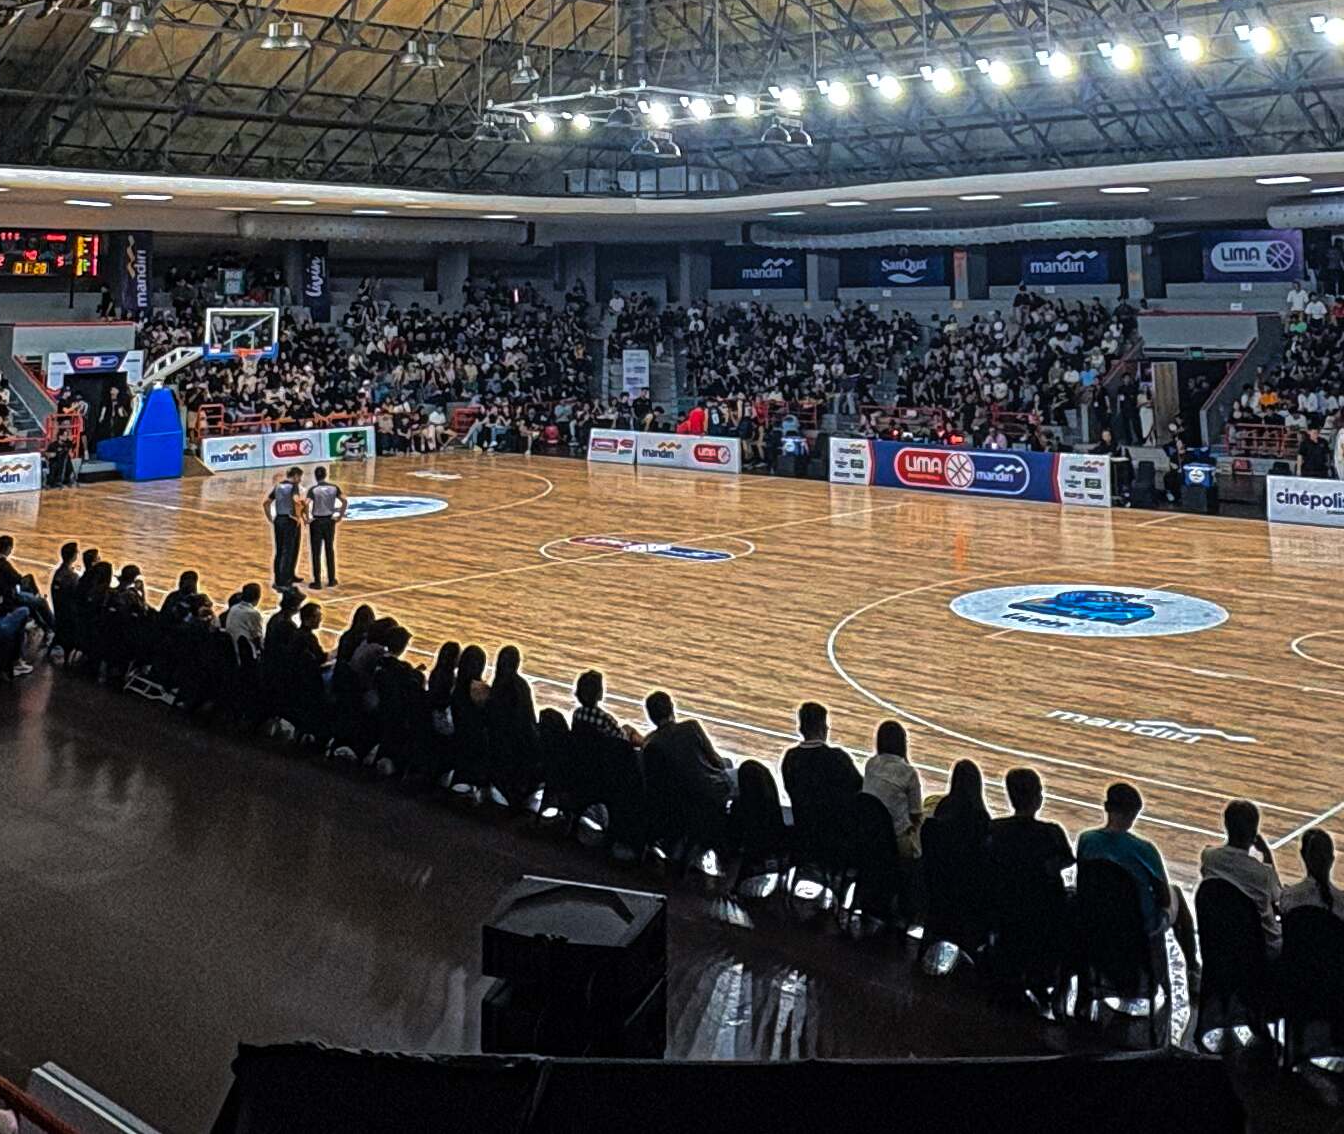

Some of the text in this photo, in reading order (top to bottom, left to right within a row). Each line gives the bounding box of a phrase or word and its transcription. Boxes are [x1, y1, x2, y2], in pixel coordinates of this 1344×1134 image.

[1221, 247, 1260, 261] LIMA
[742, 266, 783, 279] mandiri
[881, 258, 928, 273] SanQua
[1030, 259, 1084, 273] mandiri
[136, 249, 148, 308] mandiri
[211, 450, 248, 464] mandiri
[641, 448, 674, 459] mandiri
[905, 455, 943, 474] LIMA
[975, 470, 1015, 483] mandiri
[1045, 709, 1202, 745] mandiri
